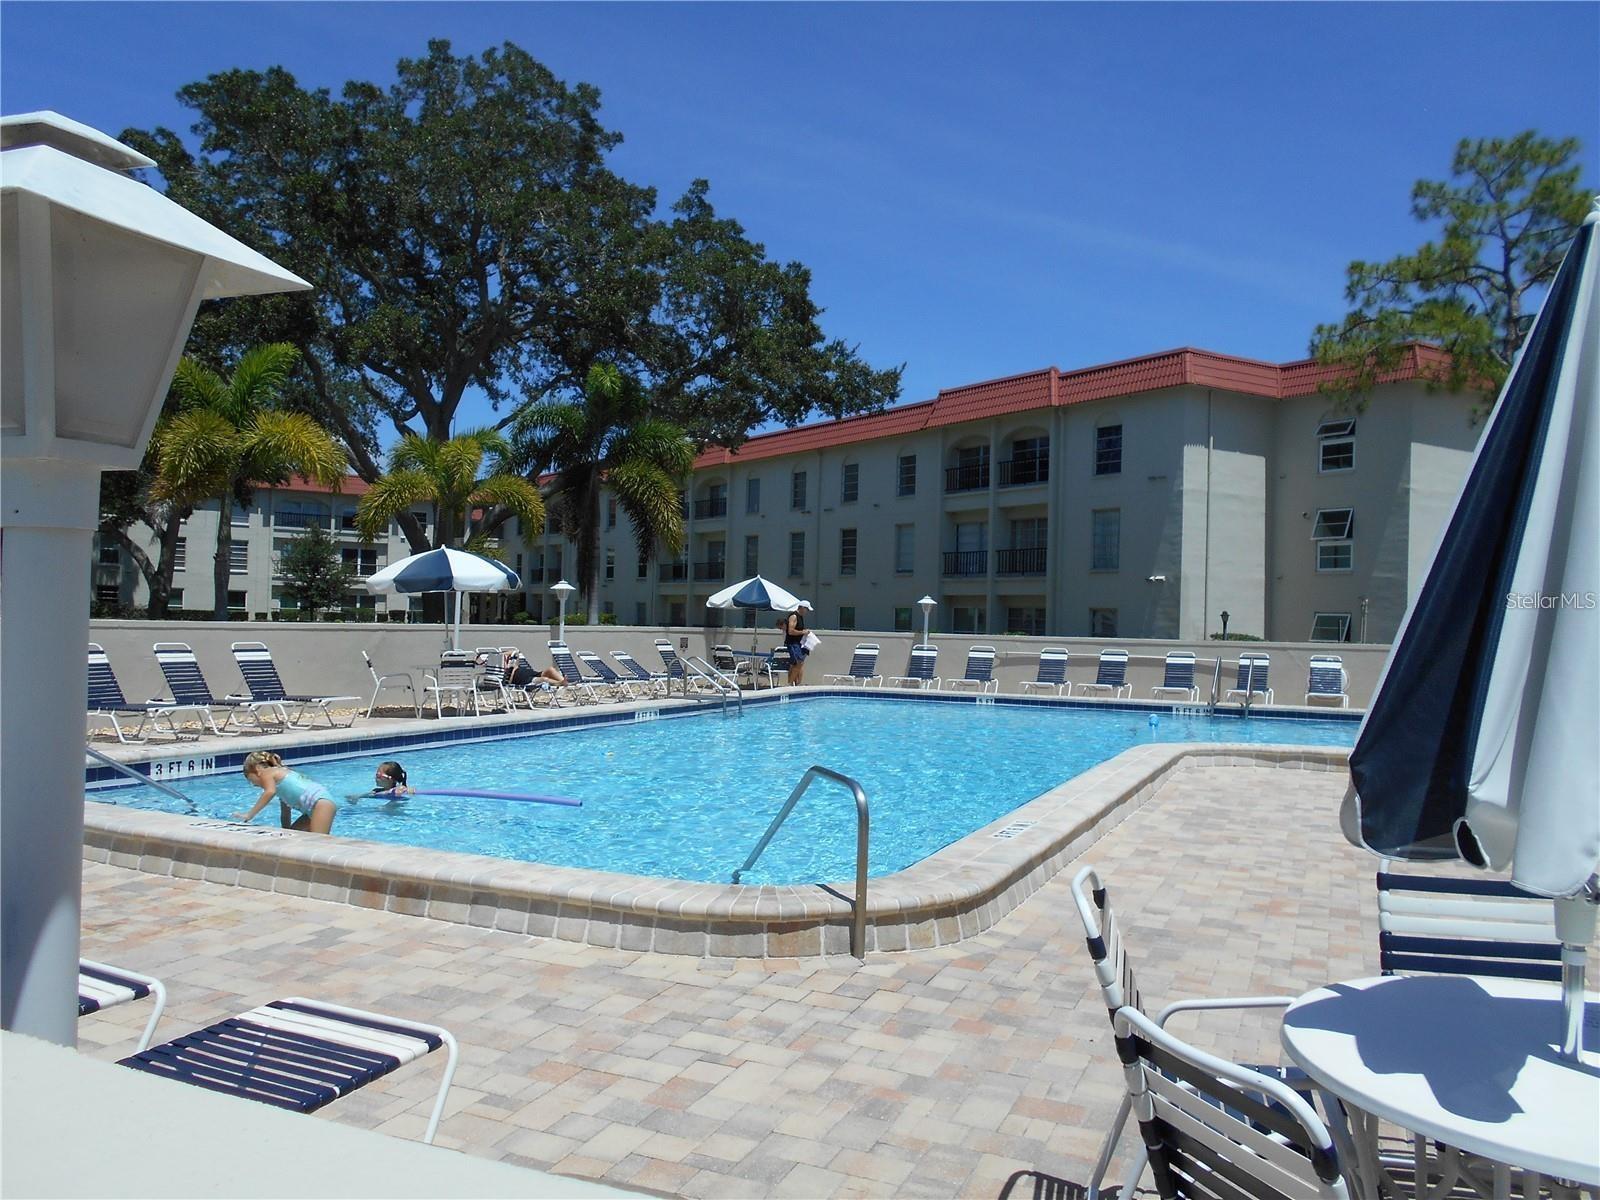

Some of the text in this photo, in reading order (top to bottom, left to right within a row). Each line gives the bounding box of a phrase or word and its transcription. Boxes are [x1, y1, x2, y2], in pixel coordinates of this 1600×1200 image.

[155, 763, 163, 775] 3
[168, 760, 182, 774] FT
[201, 757, 213, 770] IN
